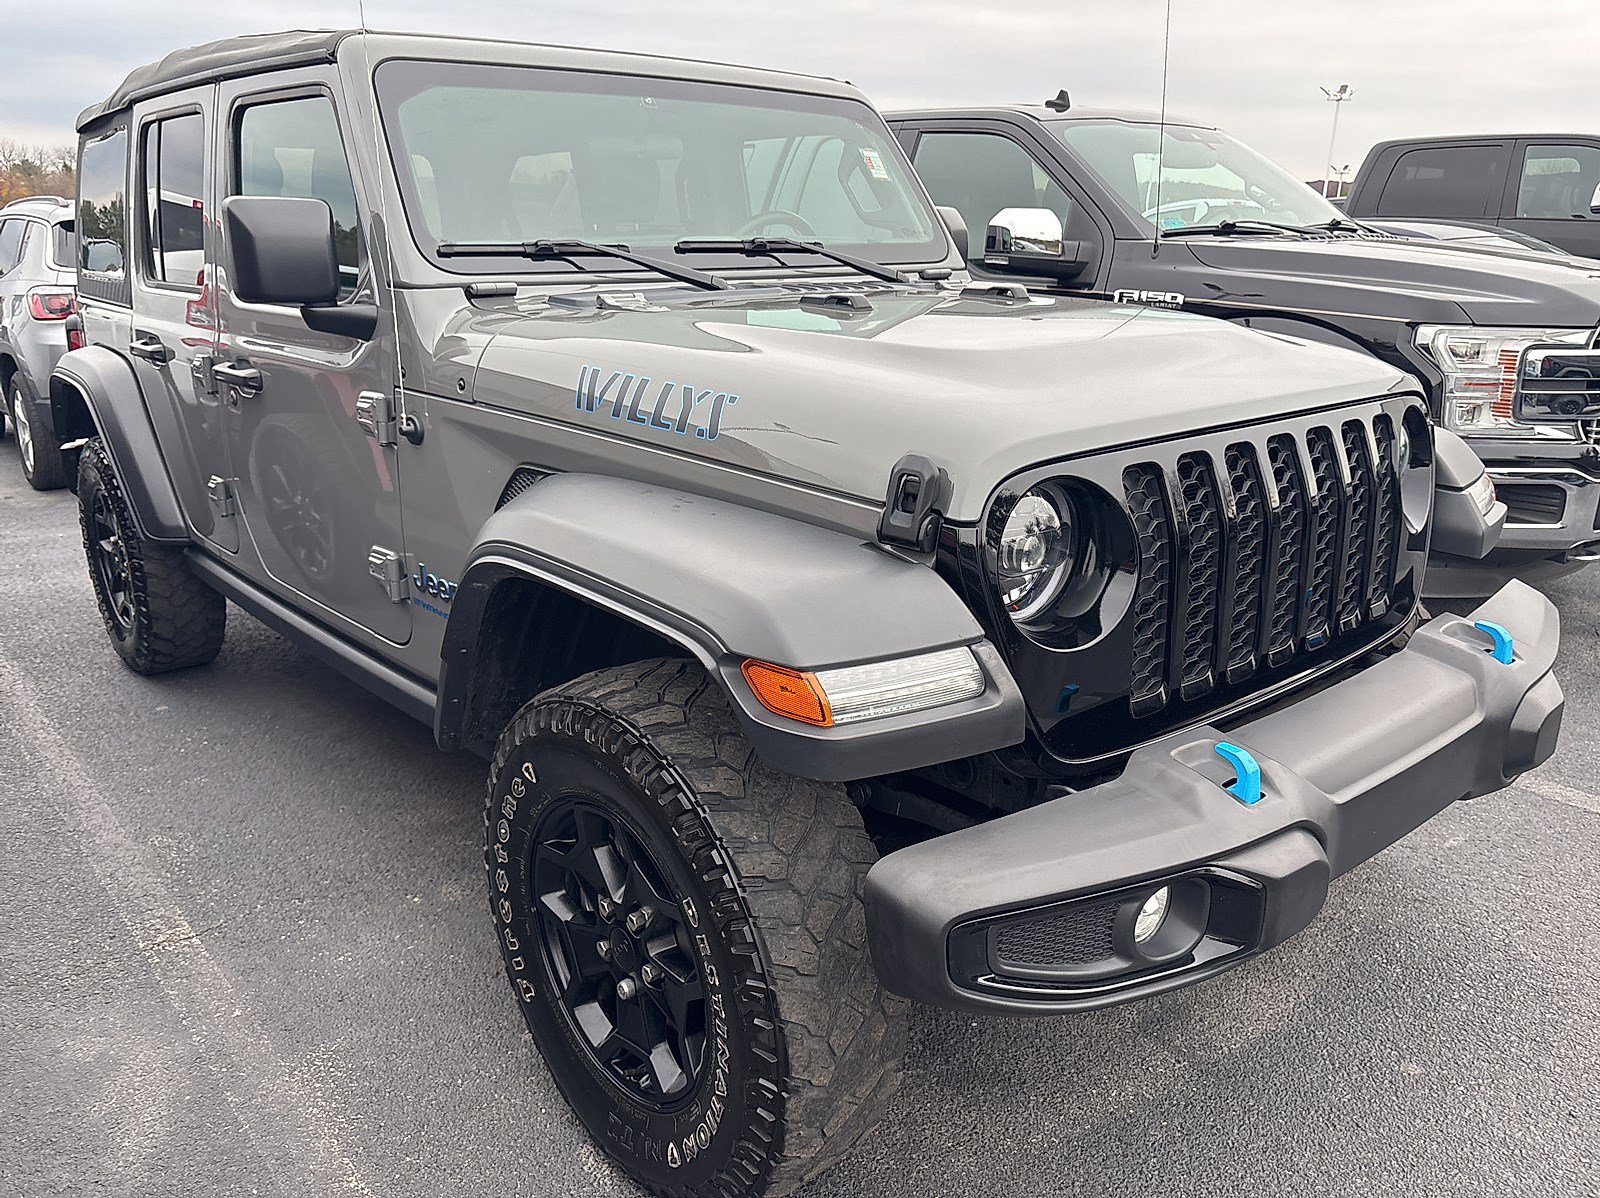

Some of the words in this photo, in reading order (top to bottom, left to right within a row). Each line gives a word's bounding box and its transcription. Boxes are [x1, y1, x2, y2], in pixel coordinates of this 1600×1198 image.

[576, 365, 739, 441] WILLYS
[493, 776, 536, 1003] Firestone
[682, 896, 731, 1163] DESTINATION
